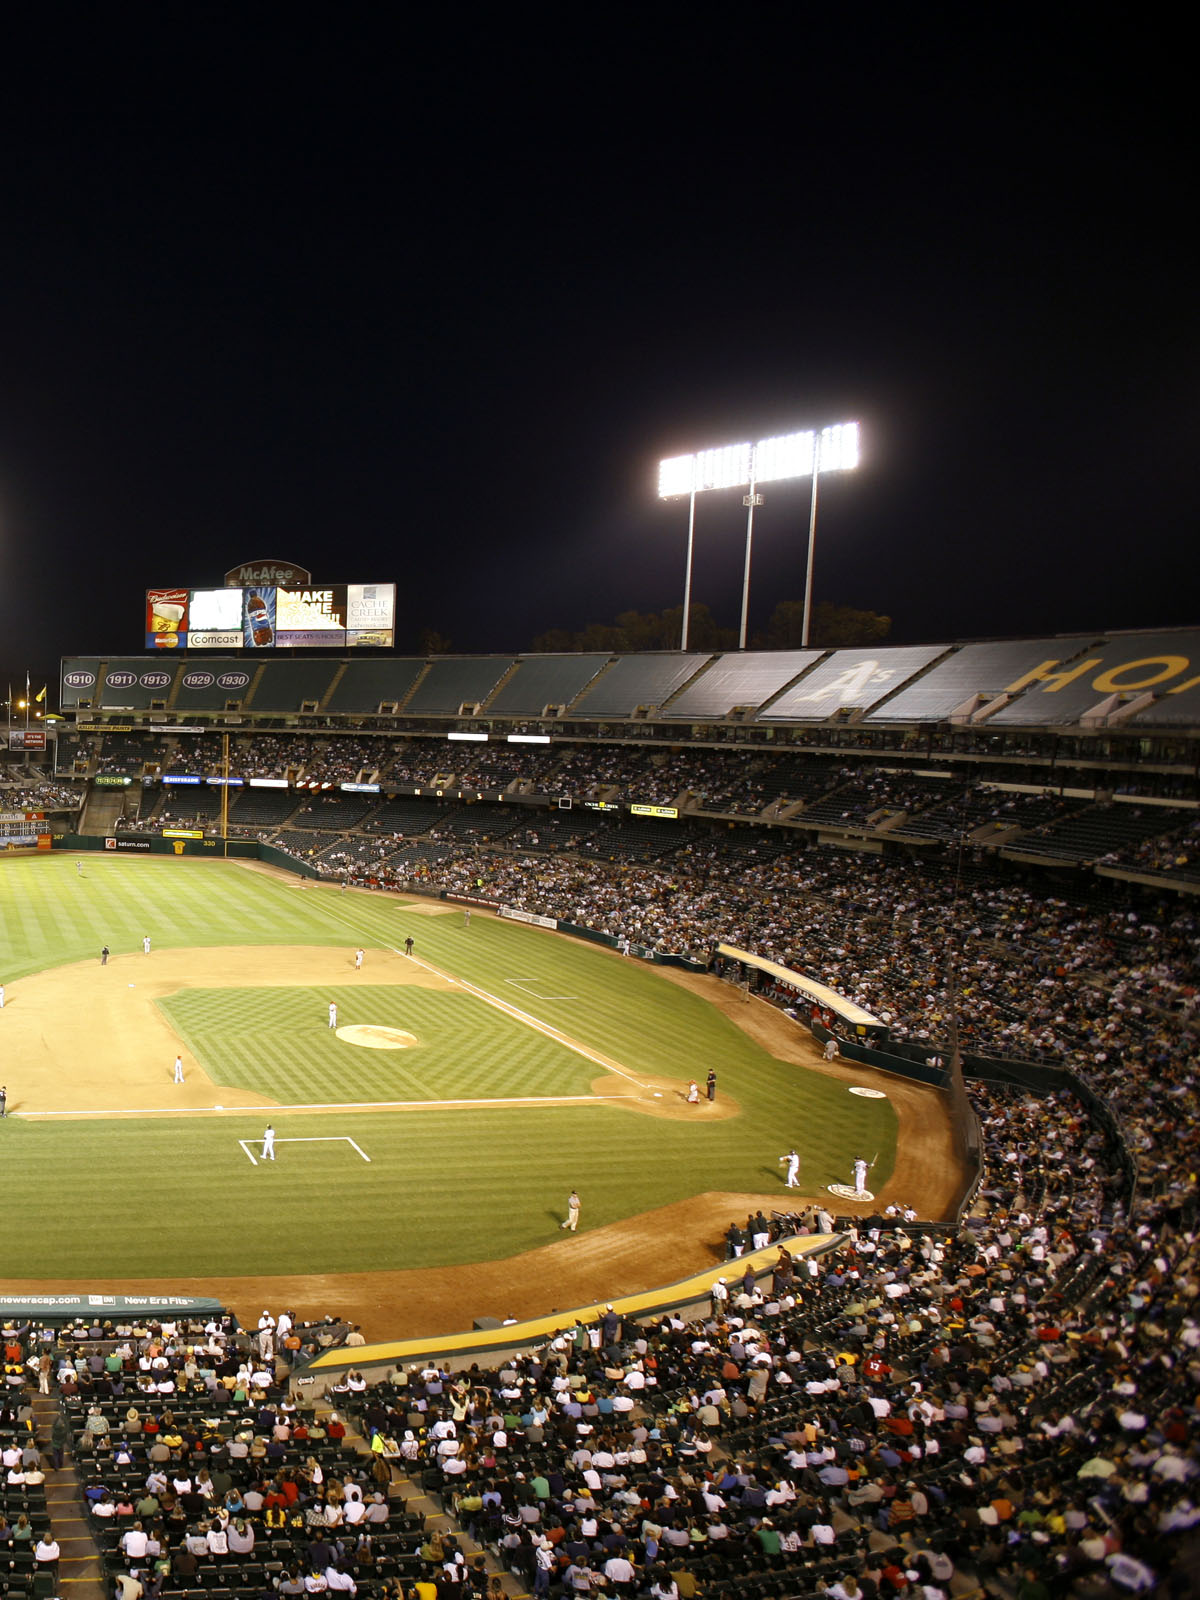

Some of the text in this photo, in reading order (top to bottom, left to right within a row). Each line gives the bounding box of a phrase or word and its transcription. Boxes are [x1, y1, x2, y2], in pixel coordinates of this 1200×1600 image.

[239, 567, 293, 580] McAfee
[150, 592, 187, 603] Budweiser
[289, 591, 333, 602] MAKE
[192, 634, 238, 646] comcast
[1004, 654, 1200, 694] HO
[68, 675, 92, 684] 1910
[109, 675, 133, 684] 1911
[144, 676, 168, 685] 1913
[186, 676, 211, 685] 1929
[221, 676, 245, 685] 1930
[799, 660, 895, 701] A's
[0, 1296, 80, 1305] neweracap.com
[869, 1361, 880, 1371] 17
[785, 1540, 797, 1550] 35
